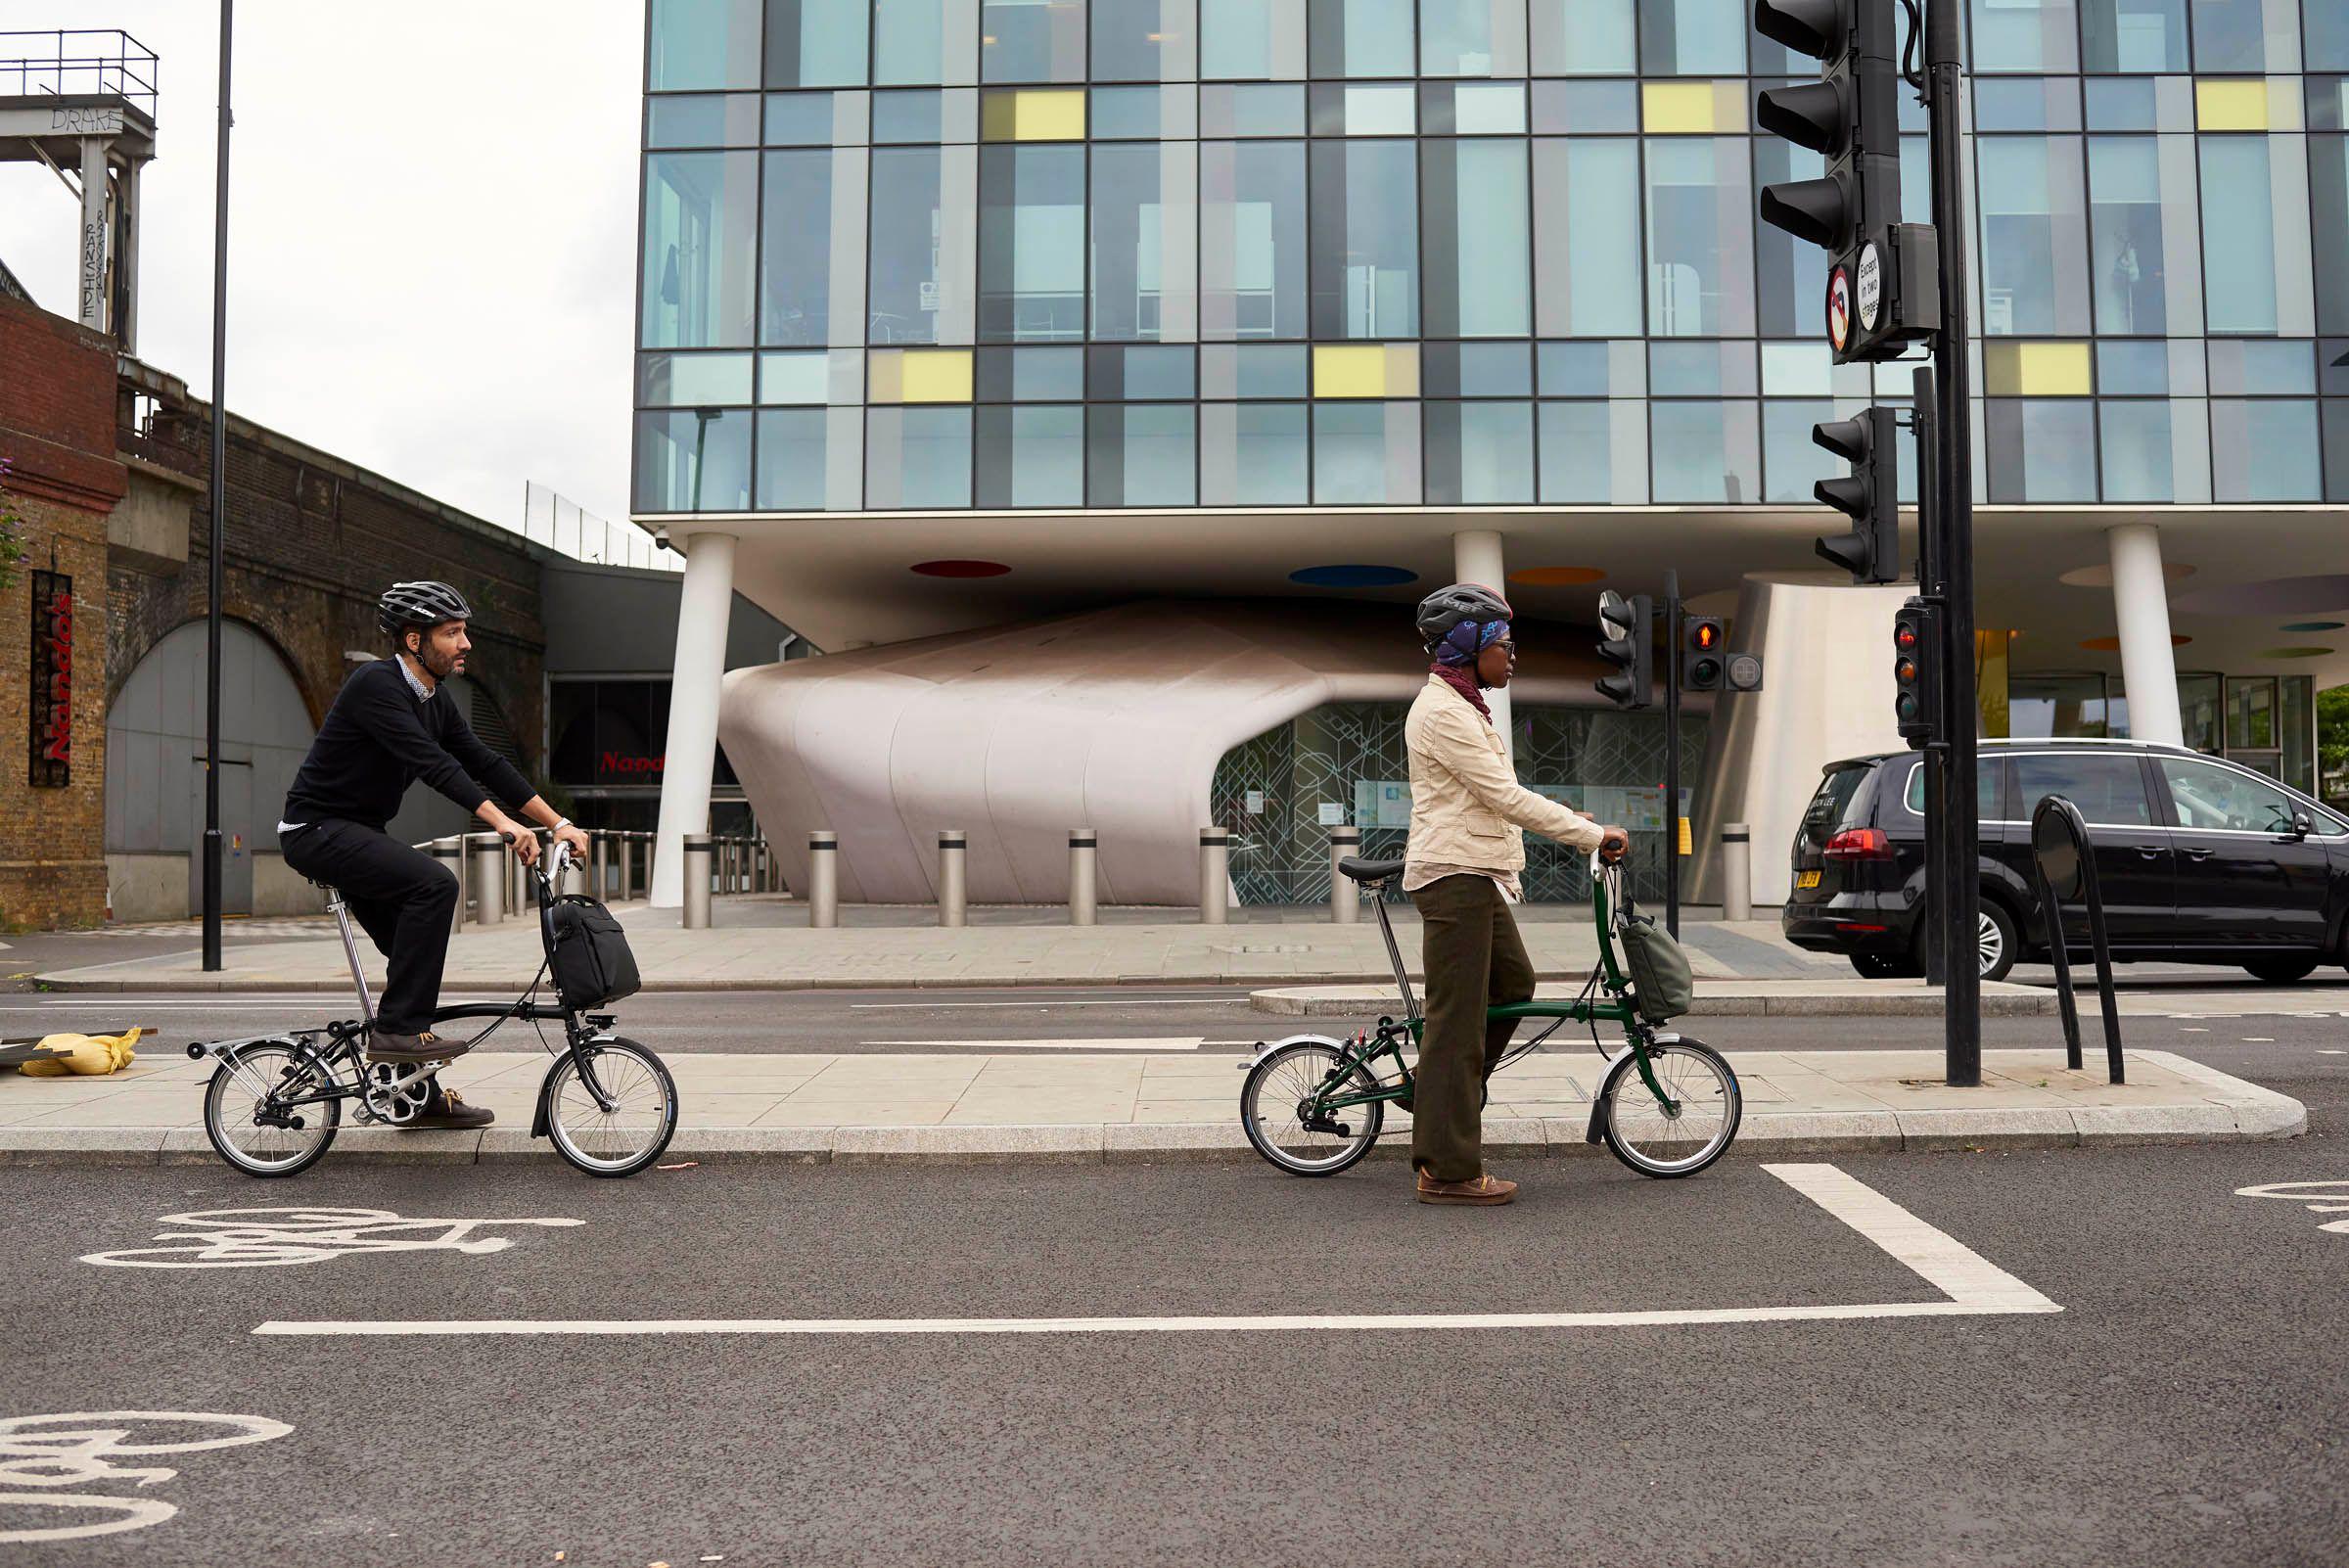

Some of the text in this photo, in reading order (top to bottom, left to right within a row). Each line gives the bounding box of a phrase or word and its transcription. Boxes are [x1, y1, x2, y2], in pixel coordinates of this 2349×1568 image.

[52, 108, 123, 133] DRAKE
[1861, 256, 1878, 279] Except
[1862, 278, 1877, 299] in two
[1862, 299, 1879, 319] stages
[1442, 597, 1482, 614] MET
[44, 593, 72, 764] Nando's
[600, 751, 666, 775] Nand
[1823, 797, 1836, 807] LEE
